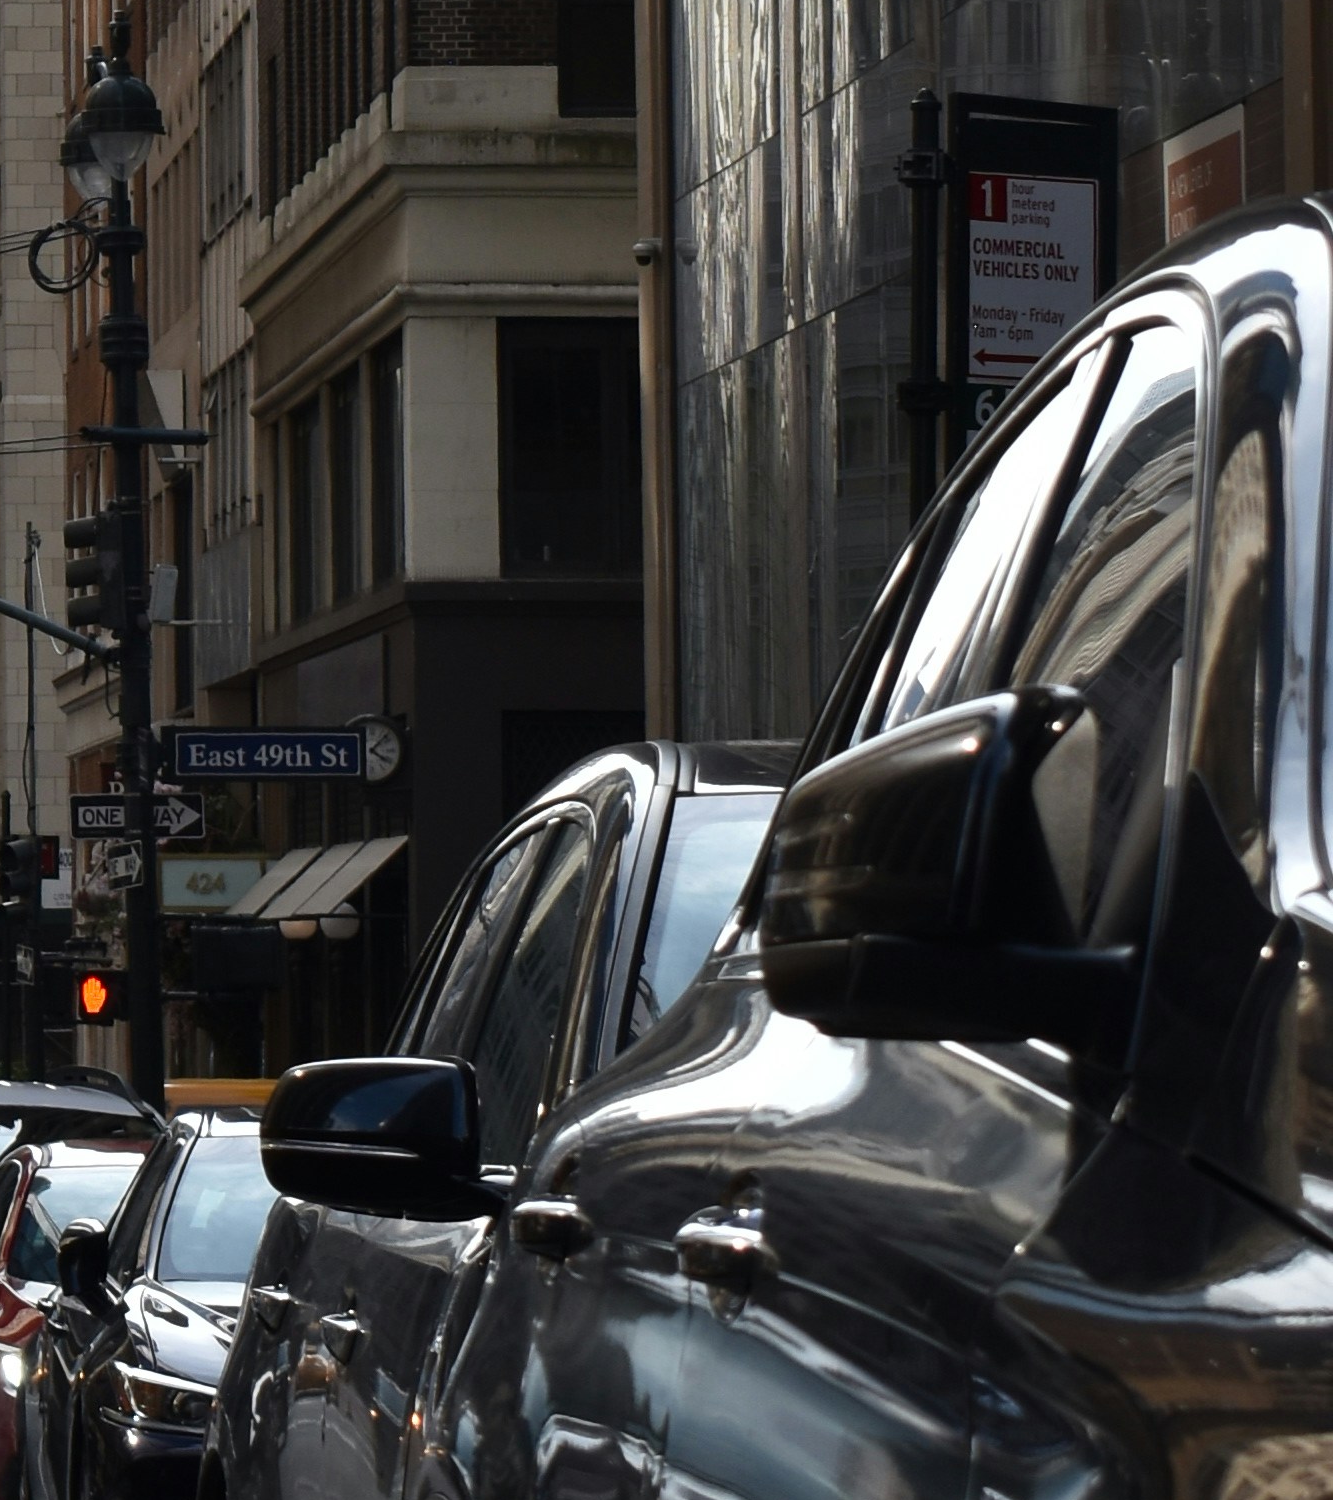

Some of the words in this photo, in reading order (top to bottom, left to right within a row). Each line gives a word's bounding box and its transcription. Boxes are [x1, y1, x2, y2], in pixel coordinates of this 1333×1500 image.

[981, 179, 993, 217] 1
[1011, 181, 1035, 195] hour
[1011, 197, 1055, 212] metered
[1011, 212, 1051, 228] parking
[973, 237, 1065, 260] COMMERCIAL
[973, 259, 1040, 280] VEHICLES
[1044, 264, 1080, 283] ONLY
[971, 304, 1019, 323] Monday
[1029, 307, 1065, 328] Friday
[973, 324, 997, 339] 7am
[1007, 325, 1034, 343] 6pm
[188, 743, 246, 767] East
[253, 743, 312, 767] 49th
[320, 743, 349, 767] St
[82, 808, 122, 826] ONE
[185, 872, 228, 896] 424
